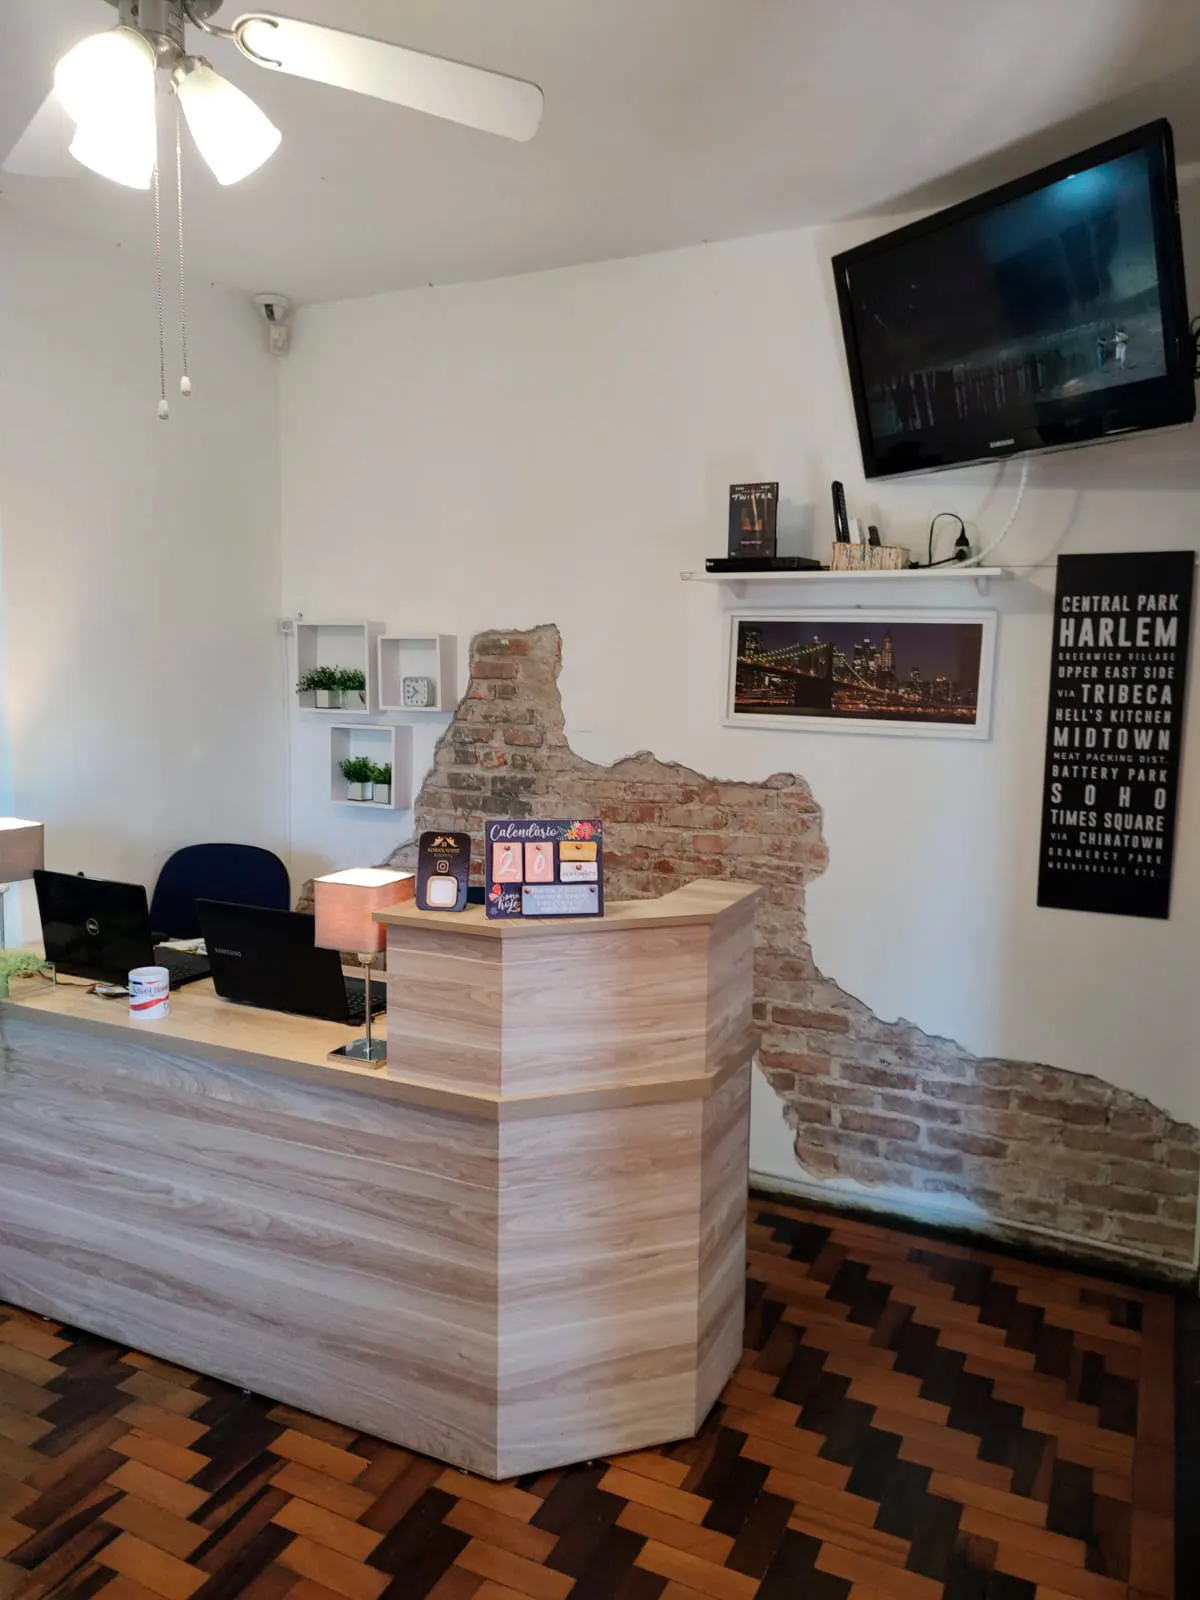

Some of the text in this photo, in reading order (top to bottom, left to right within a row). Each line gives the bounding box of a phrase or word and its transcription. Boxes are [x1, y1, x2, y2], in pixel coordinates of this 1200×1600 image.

[1061, 594, 1179, 613] CENTRAL PARK
[1059, 617, 1178, 647] HARLEM
[1058, 666, 1175, 679] UPPER EAST SIDE
[1057, 684, 1173, 705] VIA TRIBECA
[1055, 708, 1171, 723] HELL'S KITCHEN
[1053, 726, 1170, 750] MIDTOWN
[1053, 752, 1168, 764] MEAT PACKING DIST.
[1052, 765, 1168, 783] BATTERY PARK
[1050, 809, 1165, 832] TIMES SQUARE
[1050, 832, 1164, 850] VIA CHINATOWN
[498, 850, 520, 876] 2
[1048, 847, 1162, 865] GRAMERCY PARK
